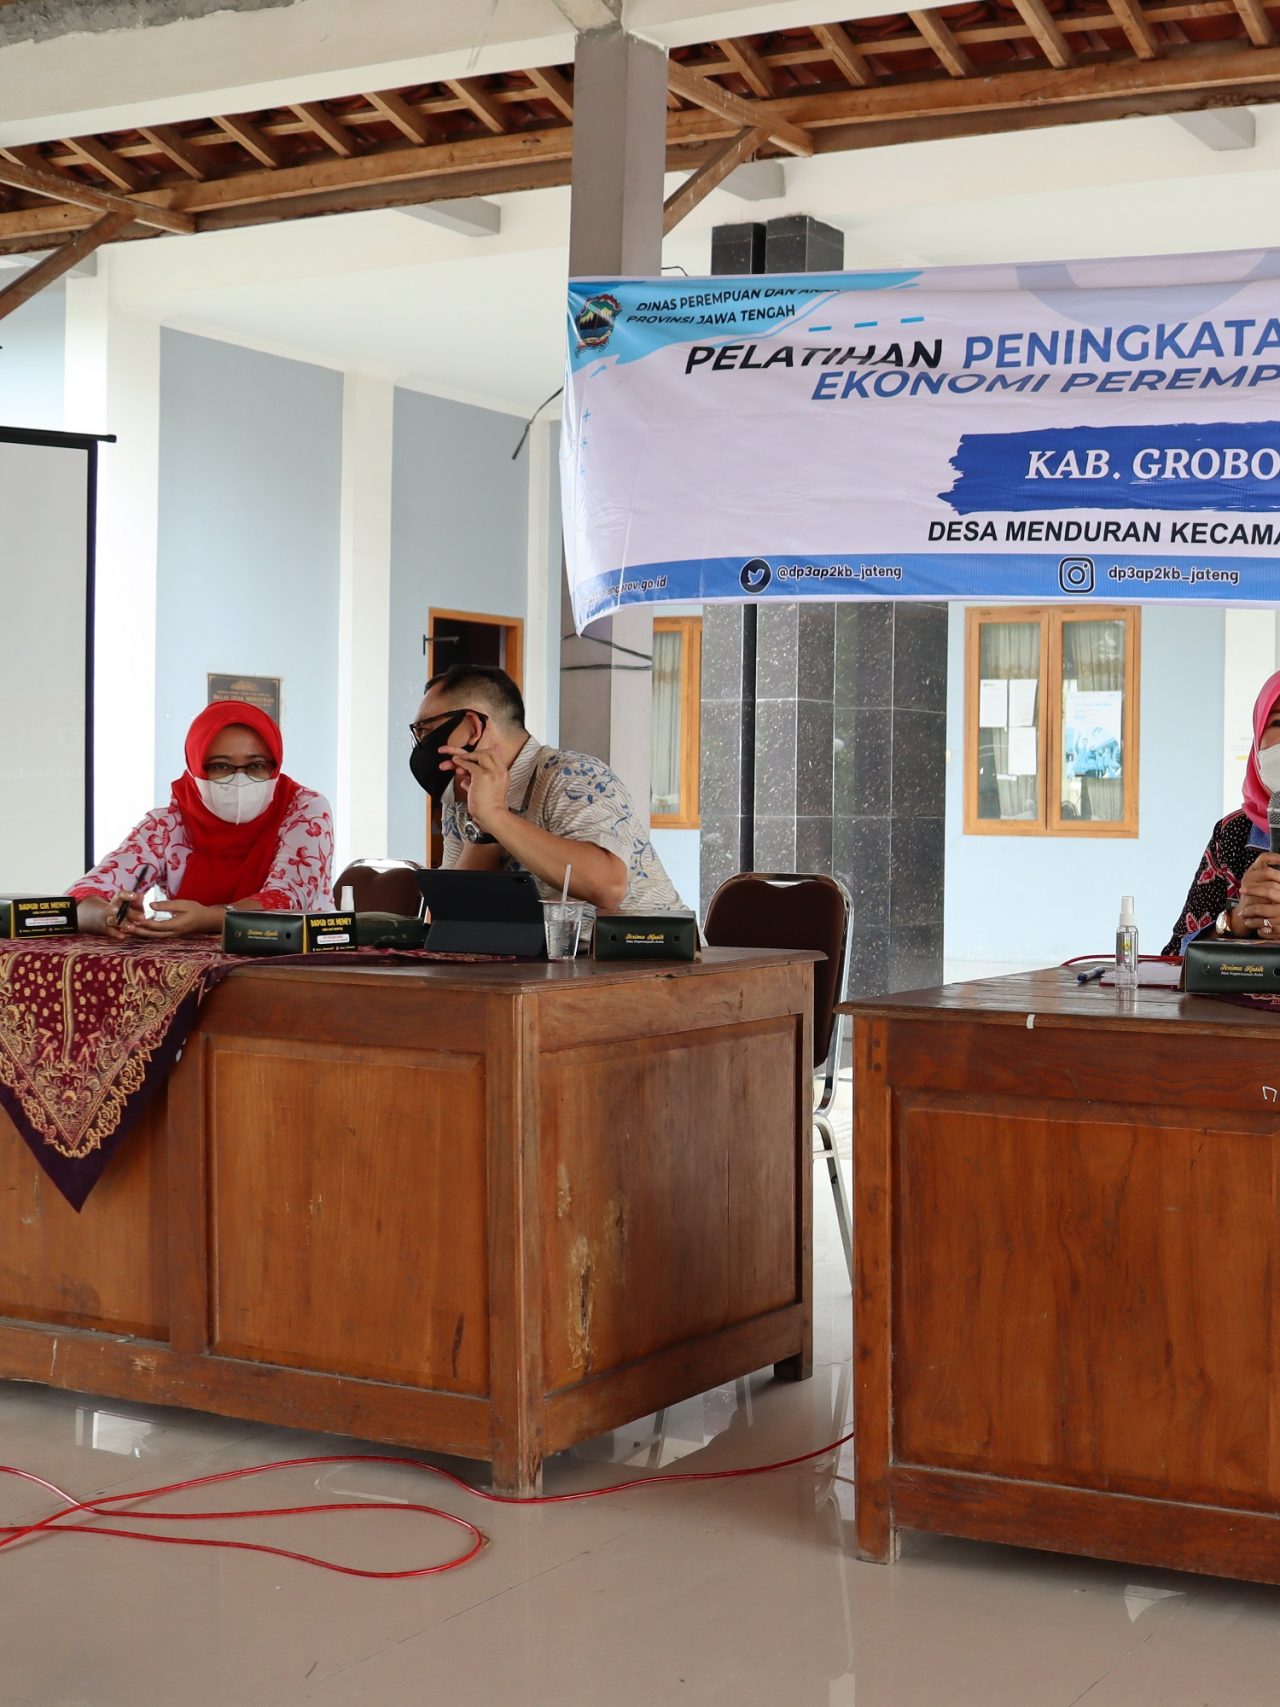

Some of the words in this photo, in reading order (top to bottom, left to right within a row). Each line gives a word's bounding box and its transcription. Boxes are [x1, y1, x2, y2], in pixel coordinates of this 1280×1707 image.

[636, 299, 677, 312] DINAS
[680, 289, 760, 309] PEREMPUAN
[763, 288, 797, 298] DAN
[798, 288, 841, 296] AN
[626, 314, 696, 324] PROVINSI
[696, 311, 736, 325] JAWA
[740, 304, 796, 321] TENGAH
[685, 338, 943, 374] PELATIHAN
[811, 370, 1051, 400] EKONOMI
[1024, 449, 1122, 480] KAB.
[927, 520, 999, 543] DESA
[1004, 521, 1161, 544] MENDURAN
[776, 564, 902, 581] @dp3ap2kb_jateng
[1108, 565, 1240, 584] dp3ap2kb_jateng
